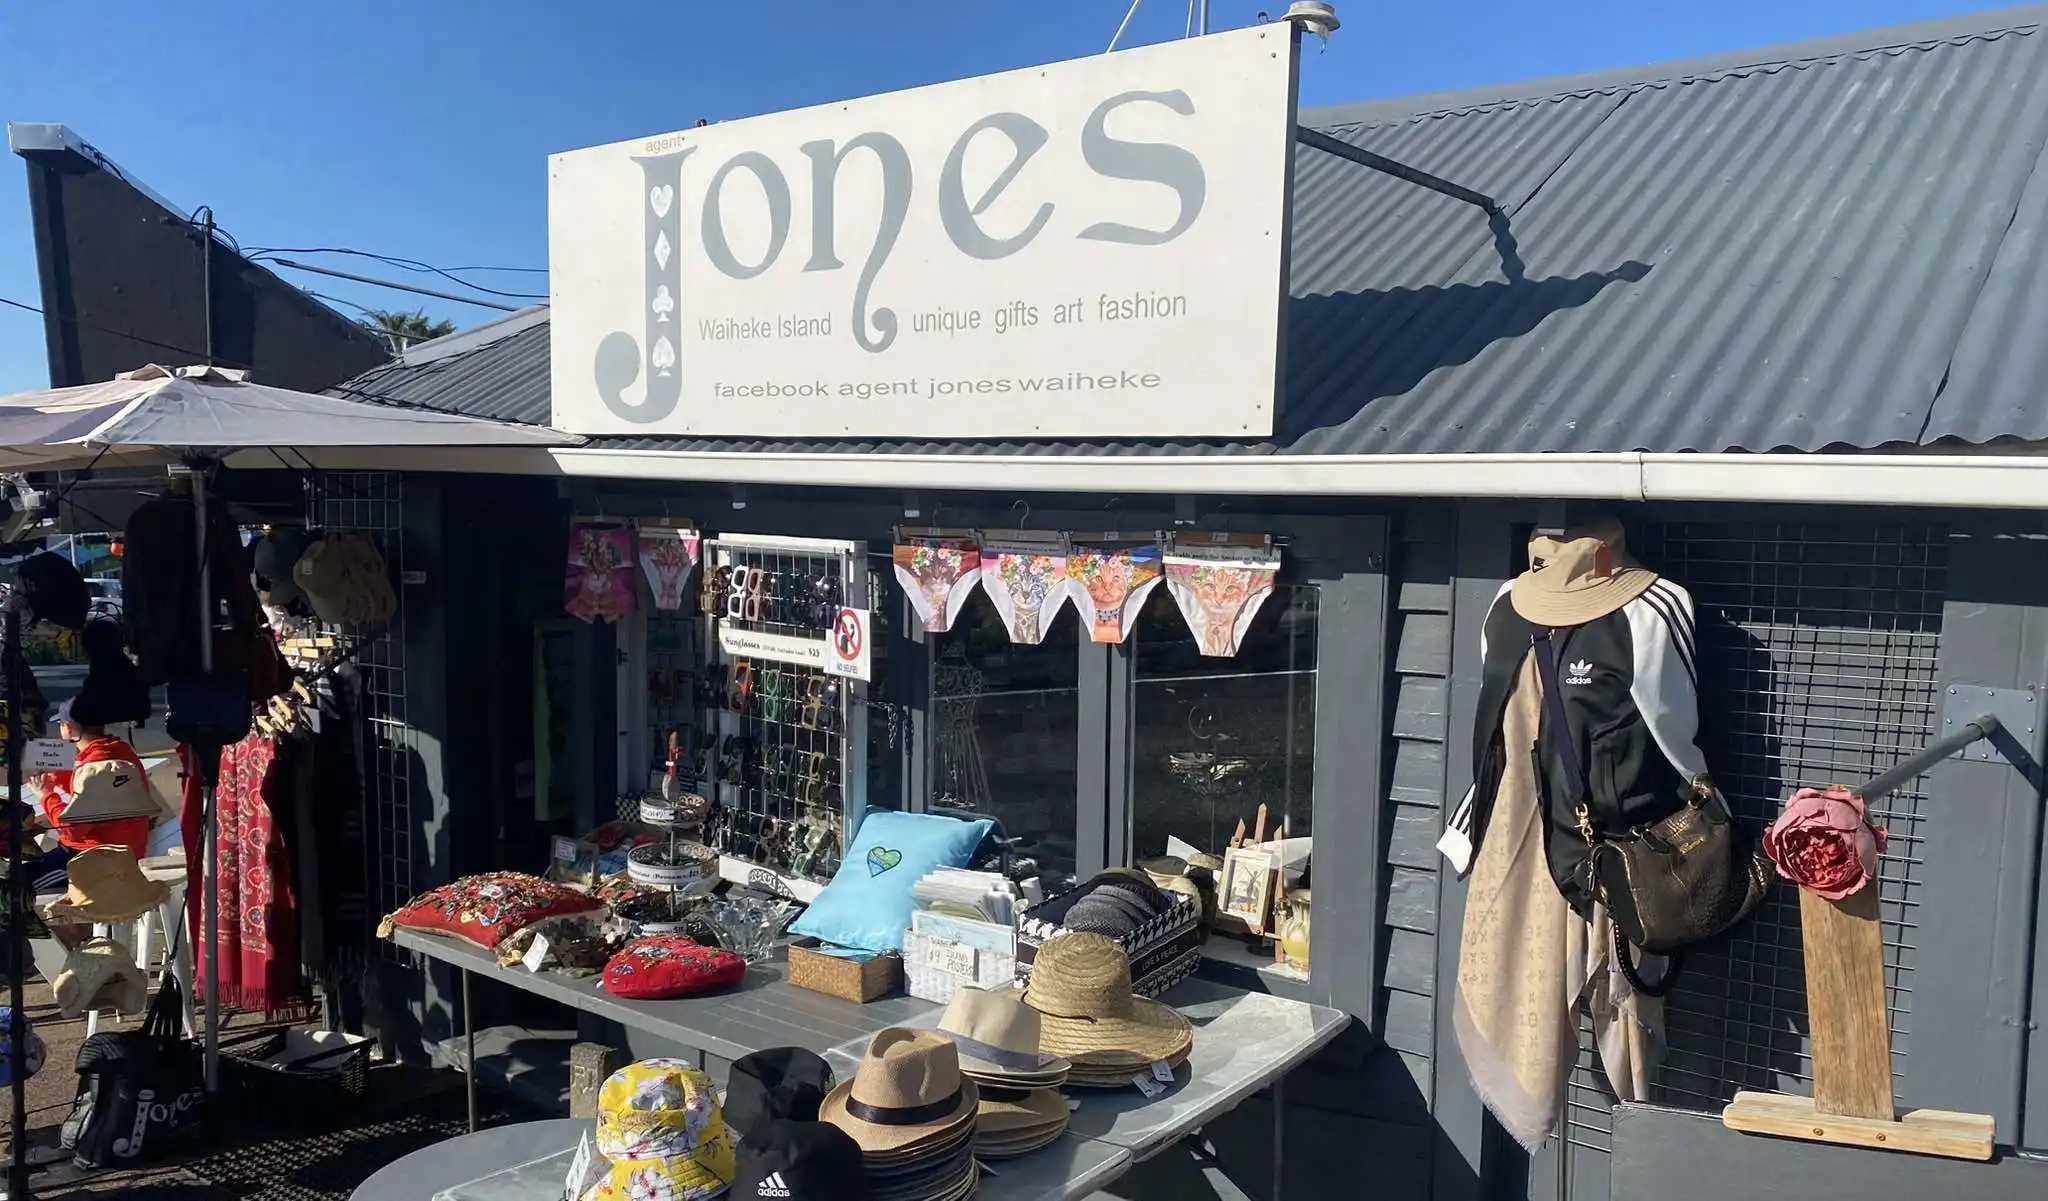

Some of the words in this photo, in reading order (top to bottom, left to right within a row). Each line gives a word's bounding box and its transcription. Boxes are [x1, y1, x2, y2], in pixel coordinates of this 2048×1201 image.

[645, 135, 681, 154] agent
[595, 89, 1206, 425] Jones
[913, 305, 981, 337] unique
[994, 300, 1039, 335] gifts
[1053, 297, 1084, 324] art
[1098, 290, 1187, 322] fashion
[700, 317, 772, 341] Waiheke
[778, 312, 832, 339] Island
[714, 380, 829, 398] facebook
[838, 379, 919, 400] agent
[927, 377, 1012, 400] jones
[1018, 370, 1161, 392] waiheke
[725, 636, 760, 652] Sunglasses
[1565, 676, 1592, 684] adidas
[757, 1187, 790, 1197] adidas
